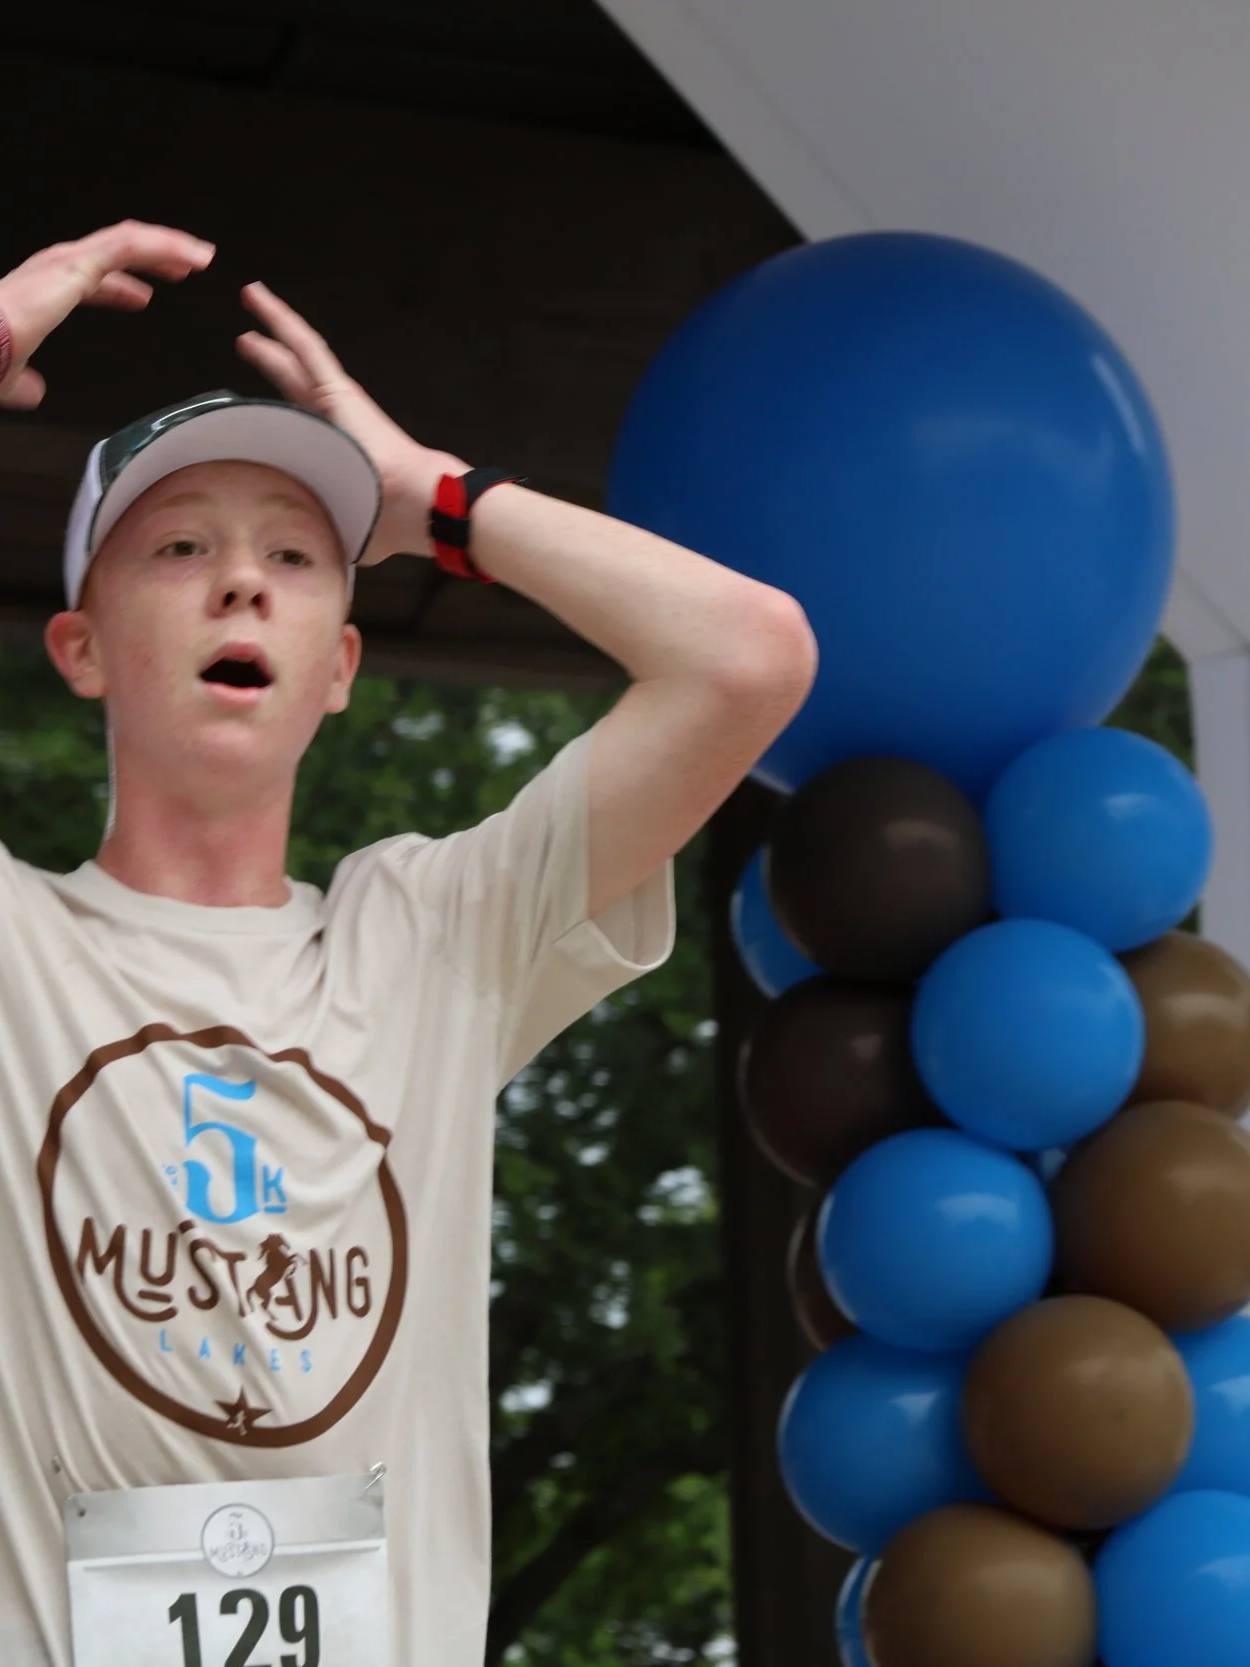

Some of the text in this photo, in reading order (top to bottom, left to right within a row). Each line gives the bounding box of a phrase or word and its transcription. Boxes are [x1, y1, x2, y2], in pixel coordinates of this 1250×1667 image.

[76, 1216, 372, 1342] MUSTANG
[158, 1327, 314, 1374] LAKES
[168, 1584, 320, 1667] 129
